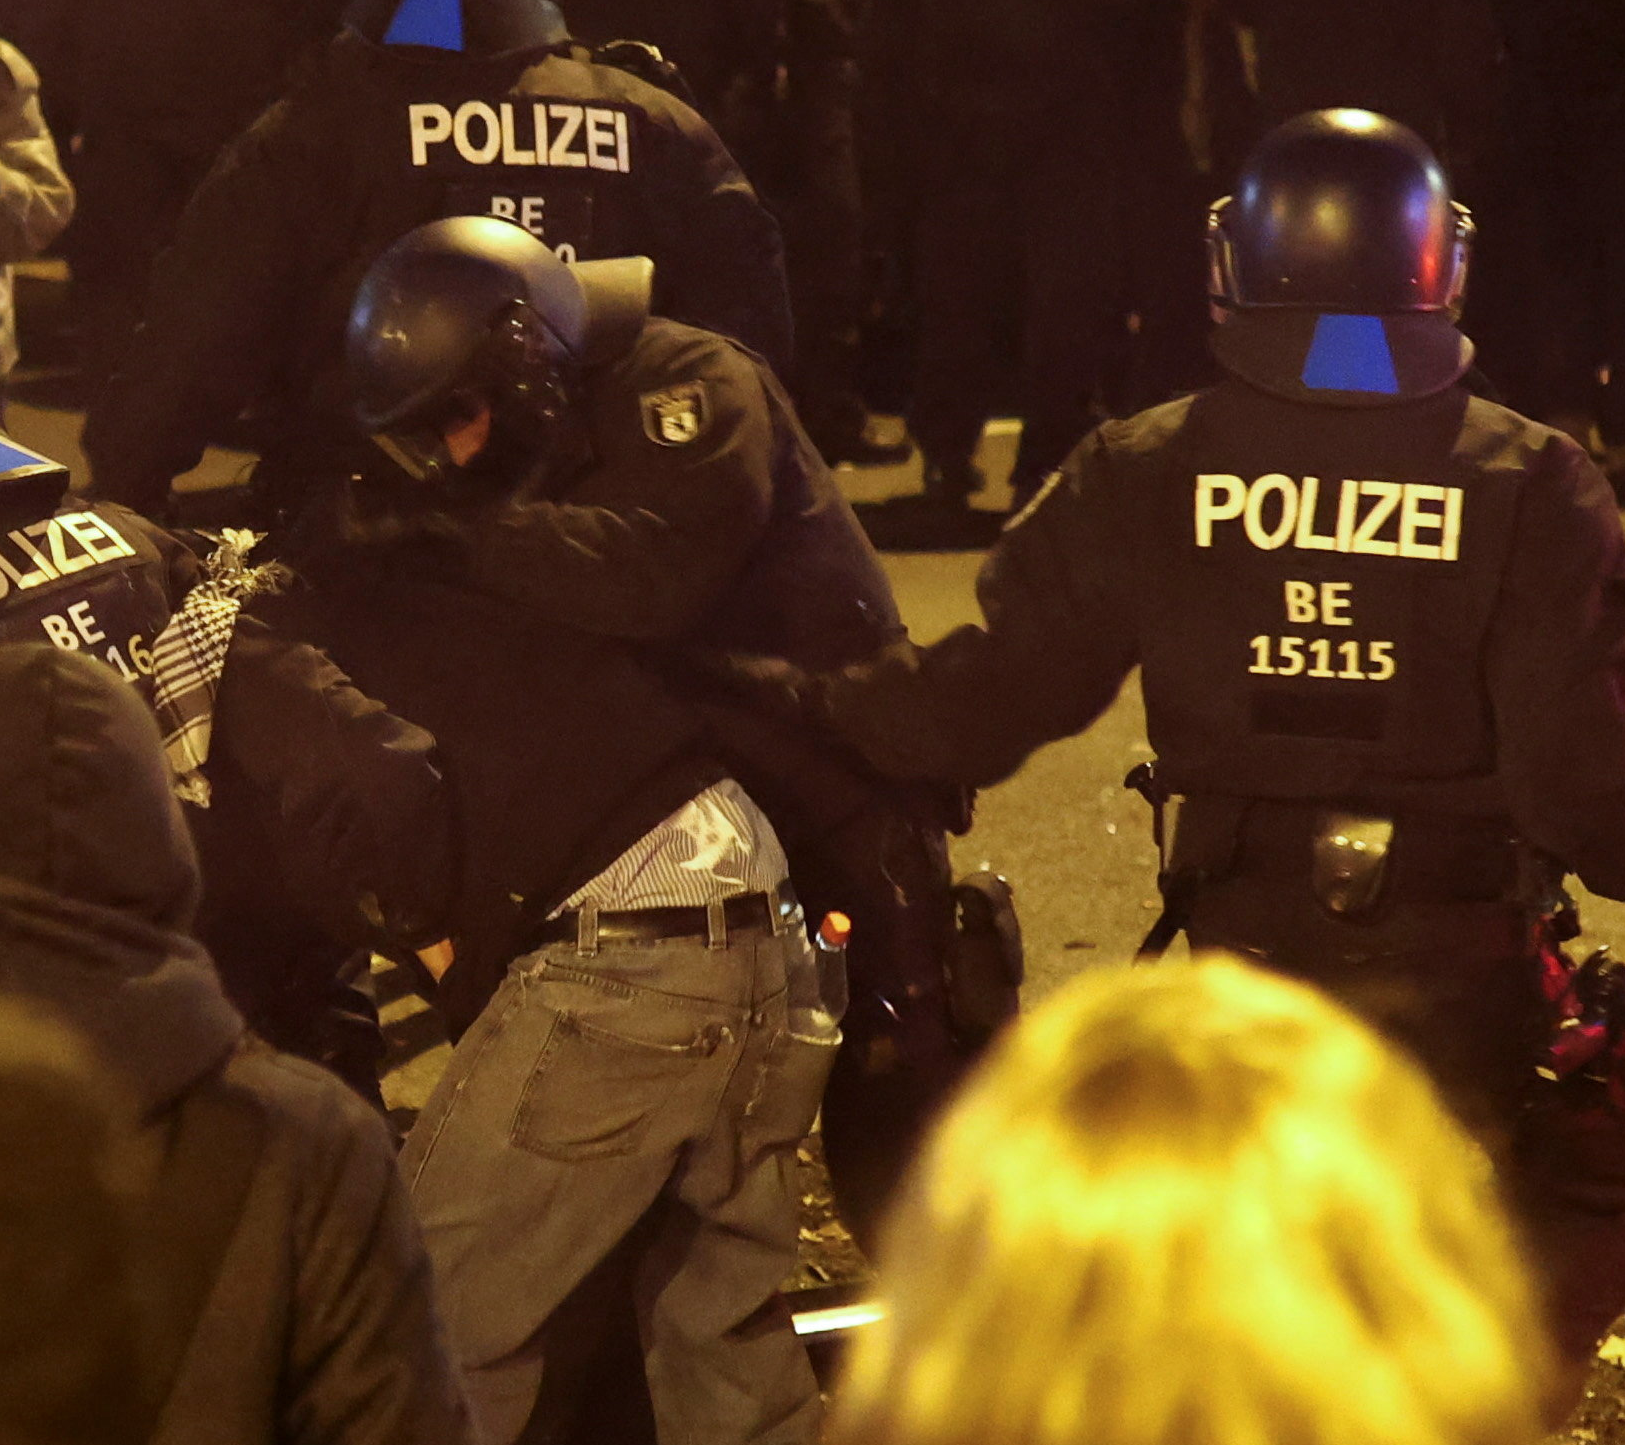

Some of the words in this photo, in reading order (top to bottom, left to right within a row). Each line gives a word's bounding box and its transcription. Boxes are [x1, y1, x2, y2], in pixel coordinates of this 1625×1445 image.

[409, 100, 630, 173] POLIZEI
[1194, 473, 1464, 561] POLIZEI
[41, 601, 106, 651] BE
[1284, 580, 1353, 626] BE
[1248, 636, 1397, 680] 15115
